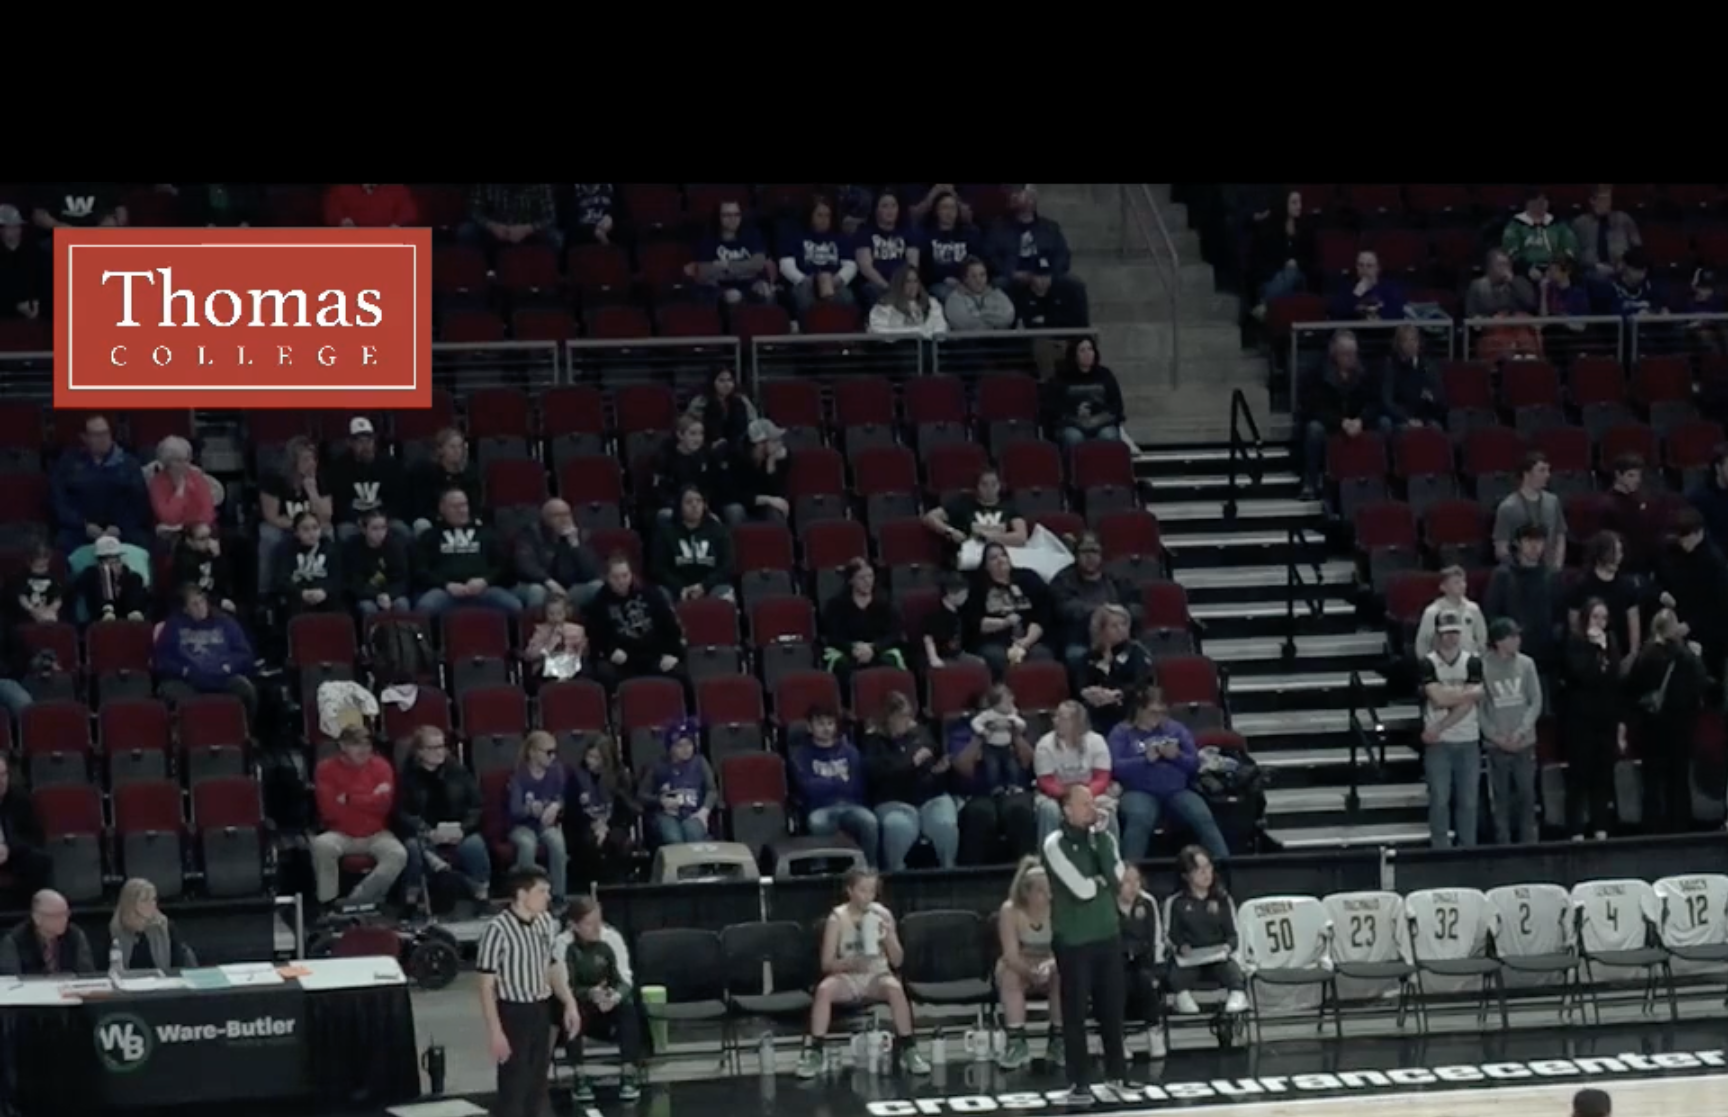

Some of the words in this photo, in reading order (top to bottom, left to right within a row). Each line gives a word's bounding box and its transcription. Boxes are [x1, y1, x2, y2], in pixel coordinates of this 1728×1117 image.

[1434, 908, 1459, 941] 32
[1519, 902, 1532, 935] 2
[1606, 900, 1618, 932] 4
[1685, 894, 1709, 928] 12
[1265, 918, 1295, 953] 50
[1351, 915, 1376, 948] 23
[155, 1015, 297, 1043] Ware-Butler
